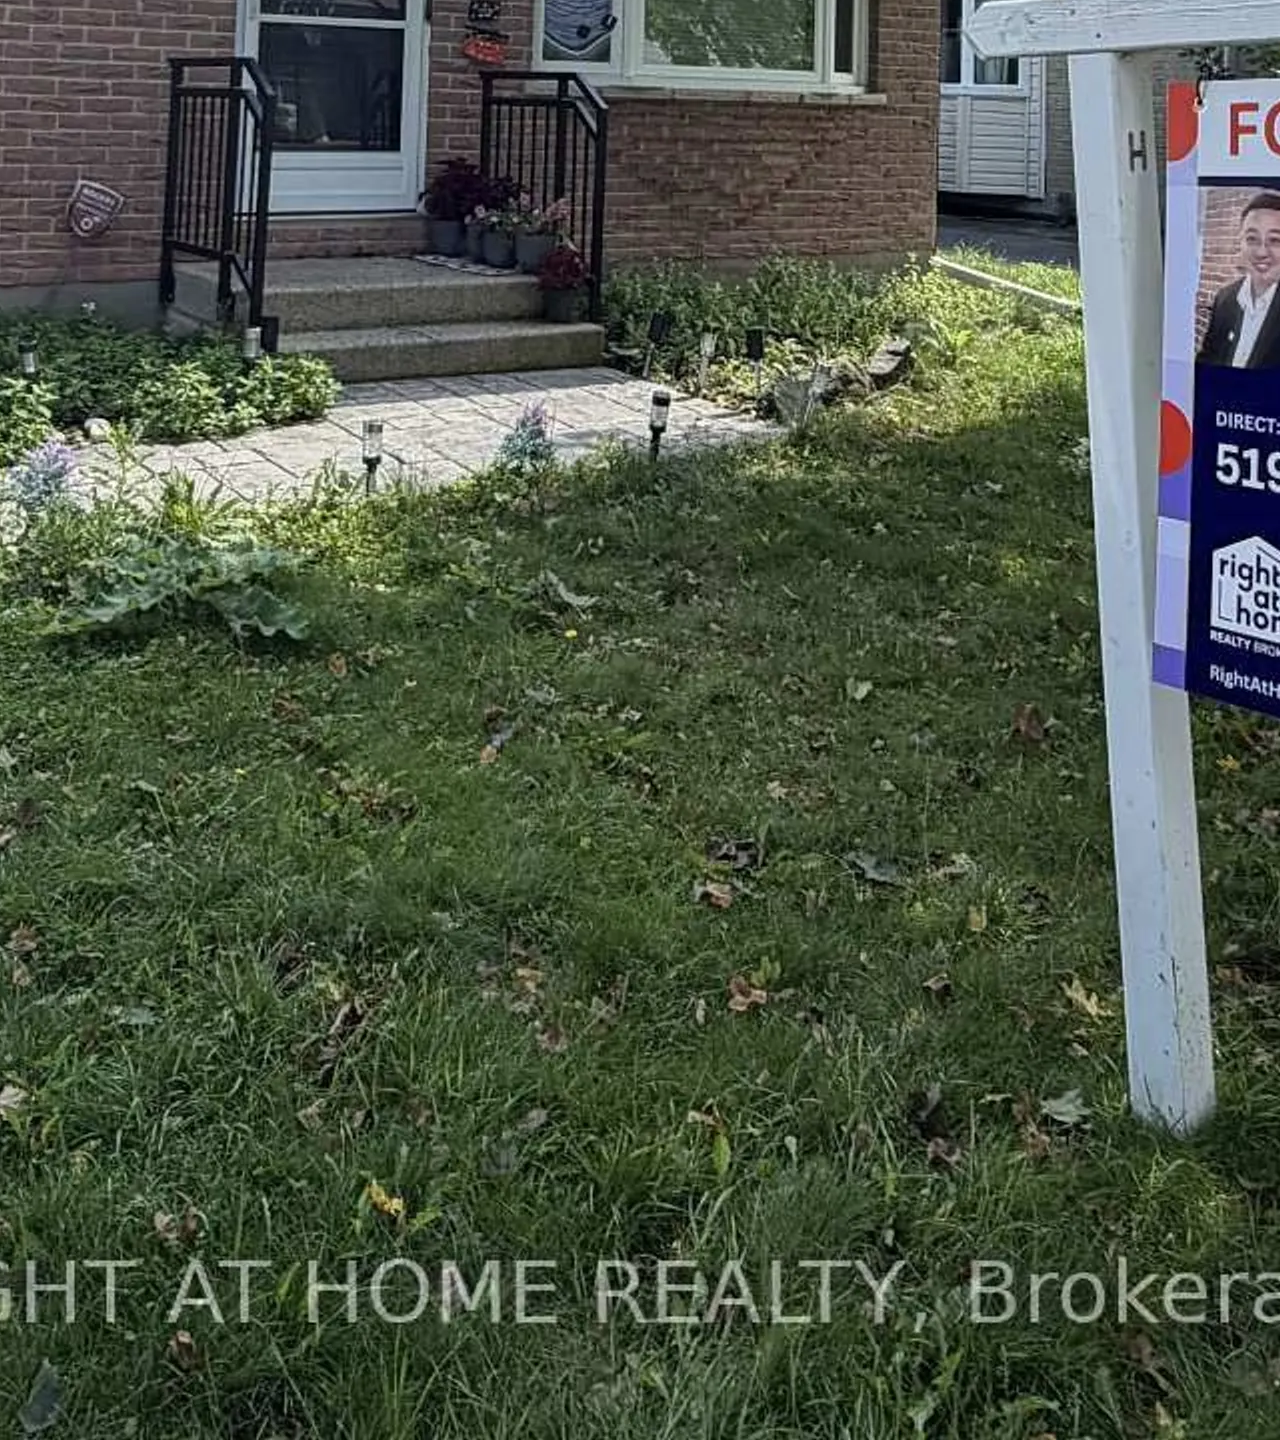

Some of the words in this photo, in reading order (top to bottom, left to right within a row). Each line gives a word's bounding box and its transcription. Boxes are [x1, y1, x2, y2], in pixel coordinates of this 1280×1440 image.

[1219, 553, 1280, 592] right
[1254, 590, 1280, 613] at
[1210, 629, 1252, 652] REALTY
